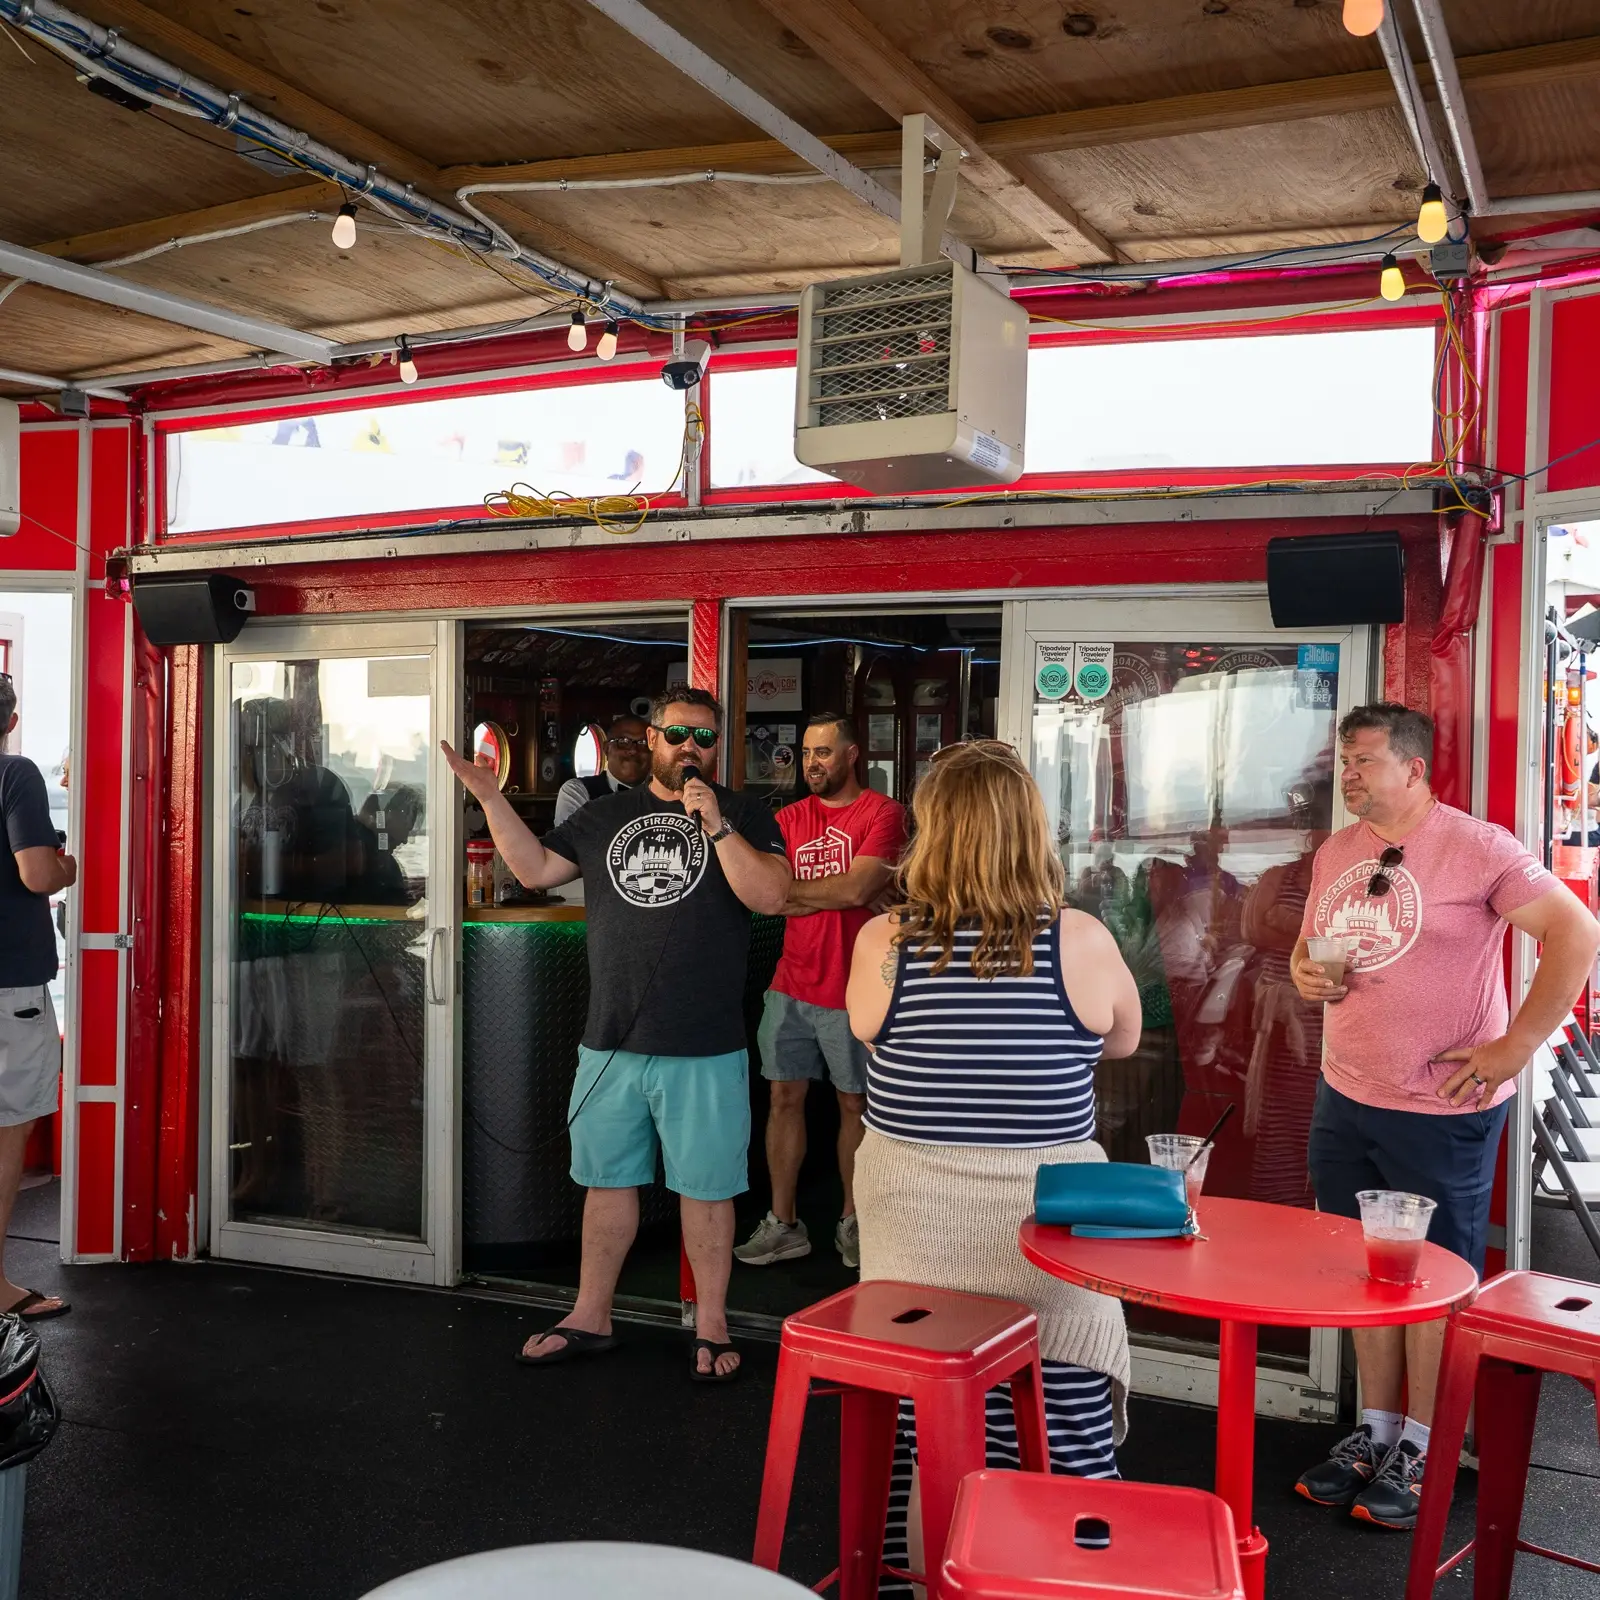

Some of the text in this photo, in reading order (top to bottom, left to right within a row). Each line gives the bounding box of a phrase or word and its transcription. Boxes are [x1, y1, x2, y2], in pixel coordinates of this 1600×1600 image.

[1113, 657, 1157, 692] BOAT TOURS
[1304, 679, 1330, 688] GLAD
[612, 823, 642, 866] CHICAGO
[643, 817, 694, 832] FIREBOAT
[655, 834, 666, 842] 41
[800, 852, 816, 863] WE
[1317, 873, 1354, 921] CHICAGO
[1400, 884, 1415, 929] TOURS
